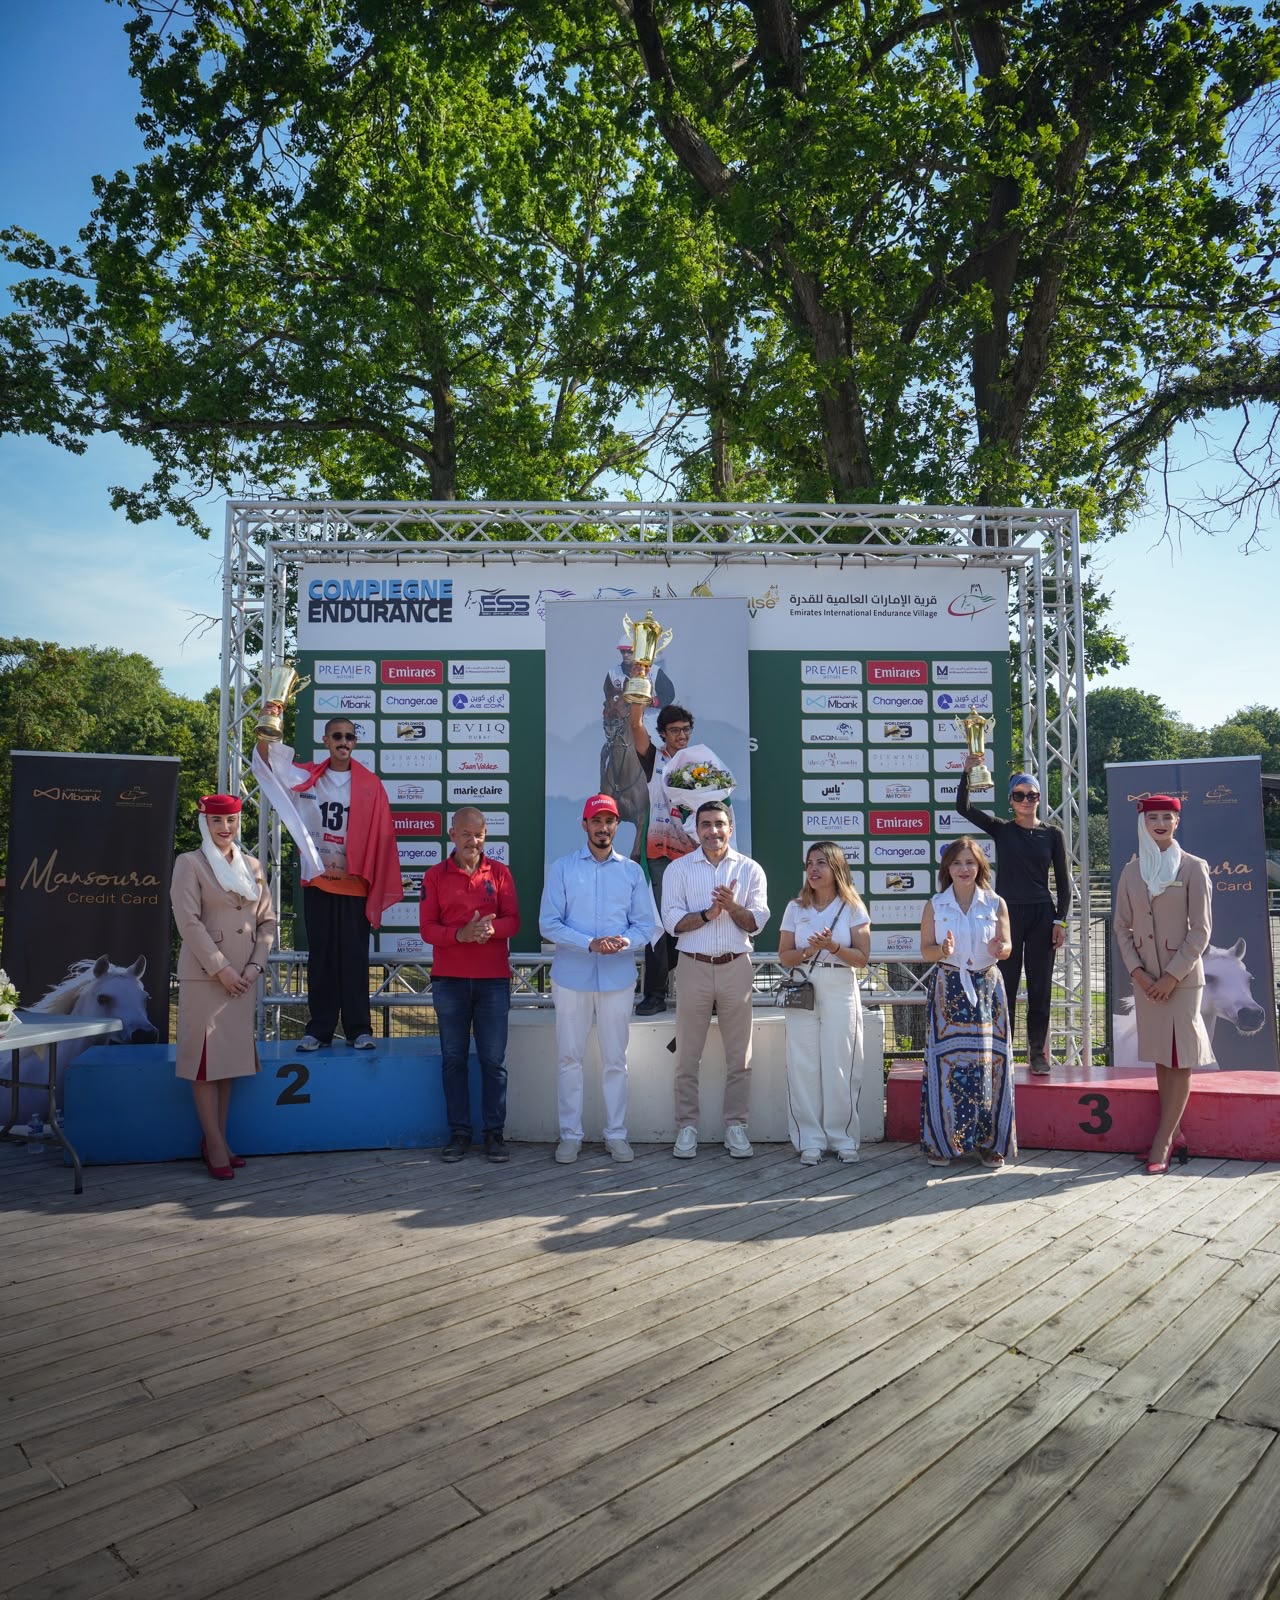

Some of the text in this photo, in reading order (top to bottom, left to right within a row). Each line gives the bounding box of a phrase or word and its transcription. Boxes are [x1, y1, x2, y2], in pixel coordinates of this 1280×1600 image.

[308, 579, 453, 601] COMPIEGNE
[480, 595, 530, 612] ESS
[789, 594, 937, 608] قرية الإمارات العالمية للقدرة
[308, 602, 453, 623] ENDURANCE
[790, 609, 938, 619] Emirates International Endurance Village
[319, 665, 371, 675] PREMIER
[388, 666, 436, 679] Emirates
[805, 665, 858, 675] PREMIER
[874, 668, 921, 679] Emirates
[340, 700, 371, 709] Mbank
[386, 696, 438, 707] Changer.ae
[828, 700, 858, 709] Mbank
[872, 696, 923, 707] Changer.ae
[452, 723, 505, 734] EVIIQ
[459, 762, 499, 771] Juan Valdez
[453, 786, 503, 795] marie claire
[821, 784, 840, 797] ياس
[62, 793, 102, 802] Mbank
[394, 818, 436, 830] mirates
[807, 816, 860, 825] PREMIER
[876, 817, 923, 829] Emirates
[398, 848, 438, 859] anger.ae
[844, 850, 860, 860] ank
[874, 846, 926, 858] Changer.ae
[20, 849, 161, 893] Mansoura
[1216, 881, 1252, 891] Card
[67, 892, 158, 905] Credit Card
[275, 1063, 312, 1105] 2
[1078, 1094, 1113, 1134] 3
